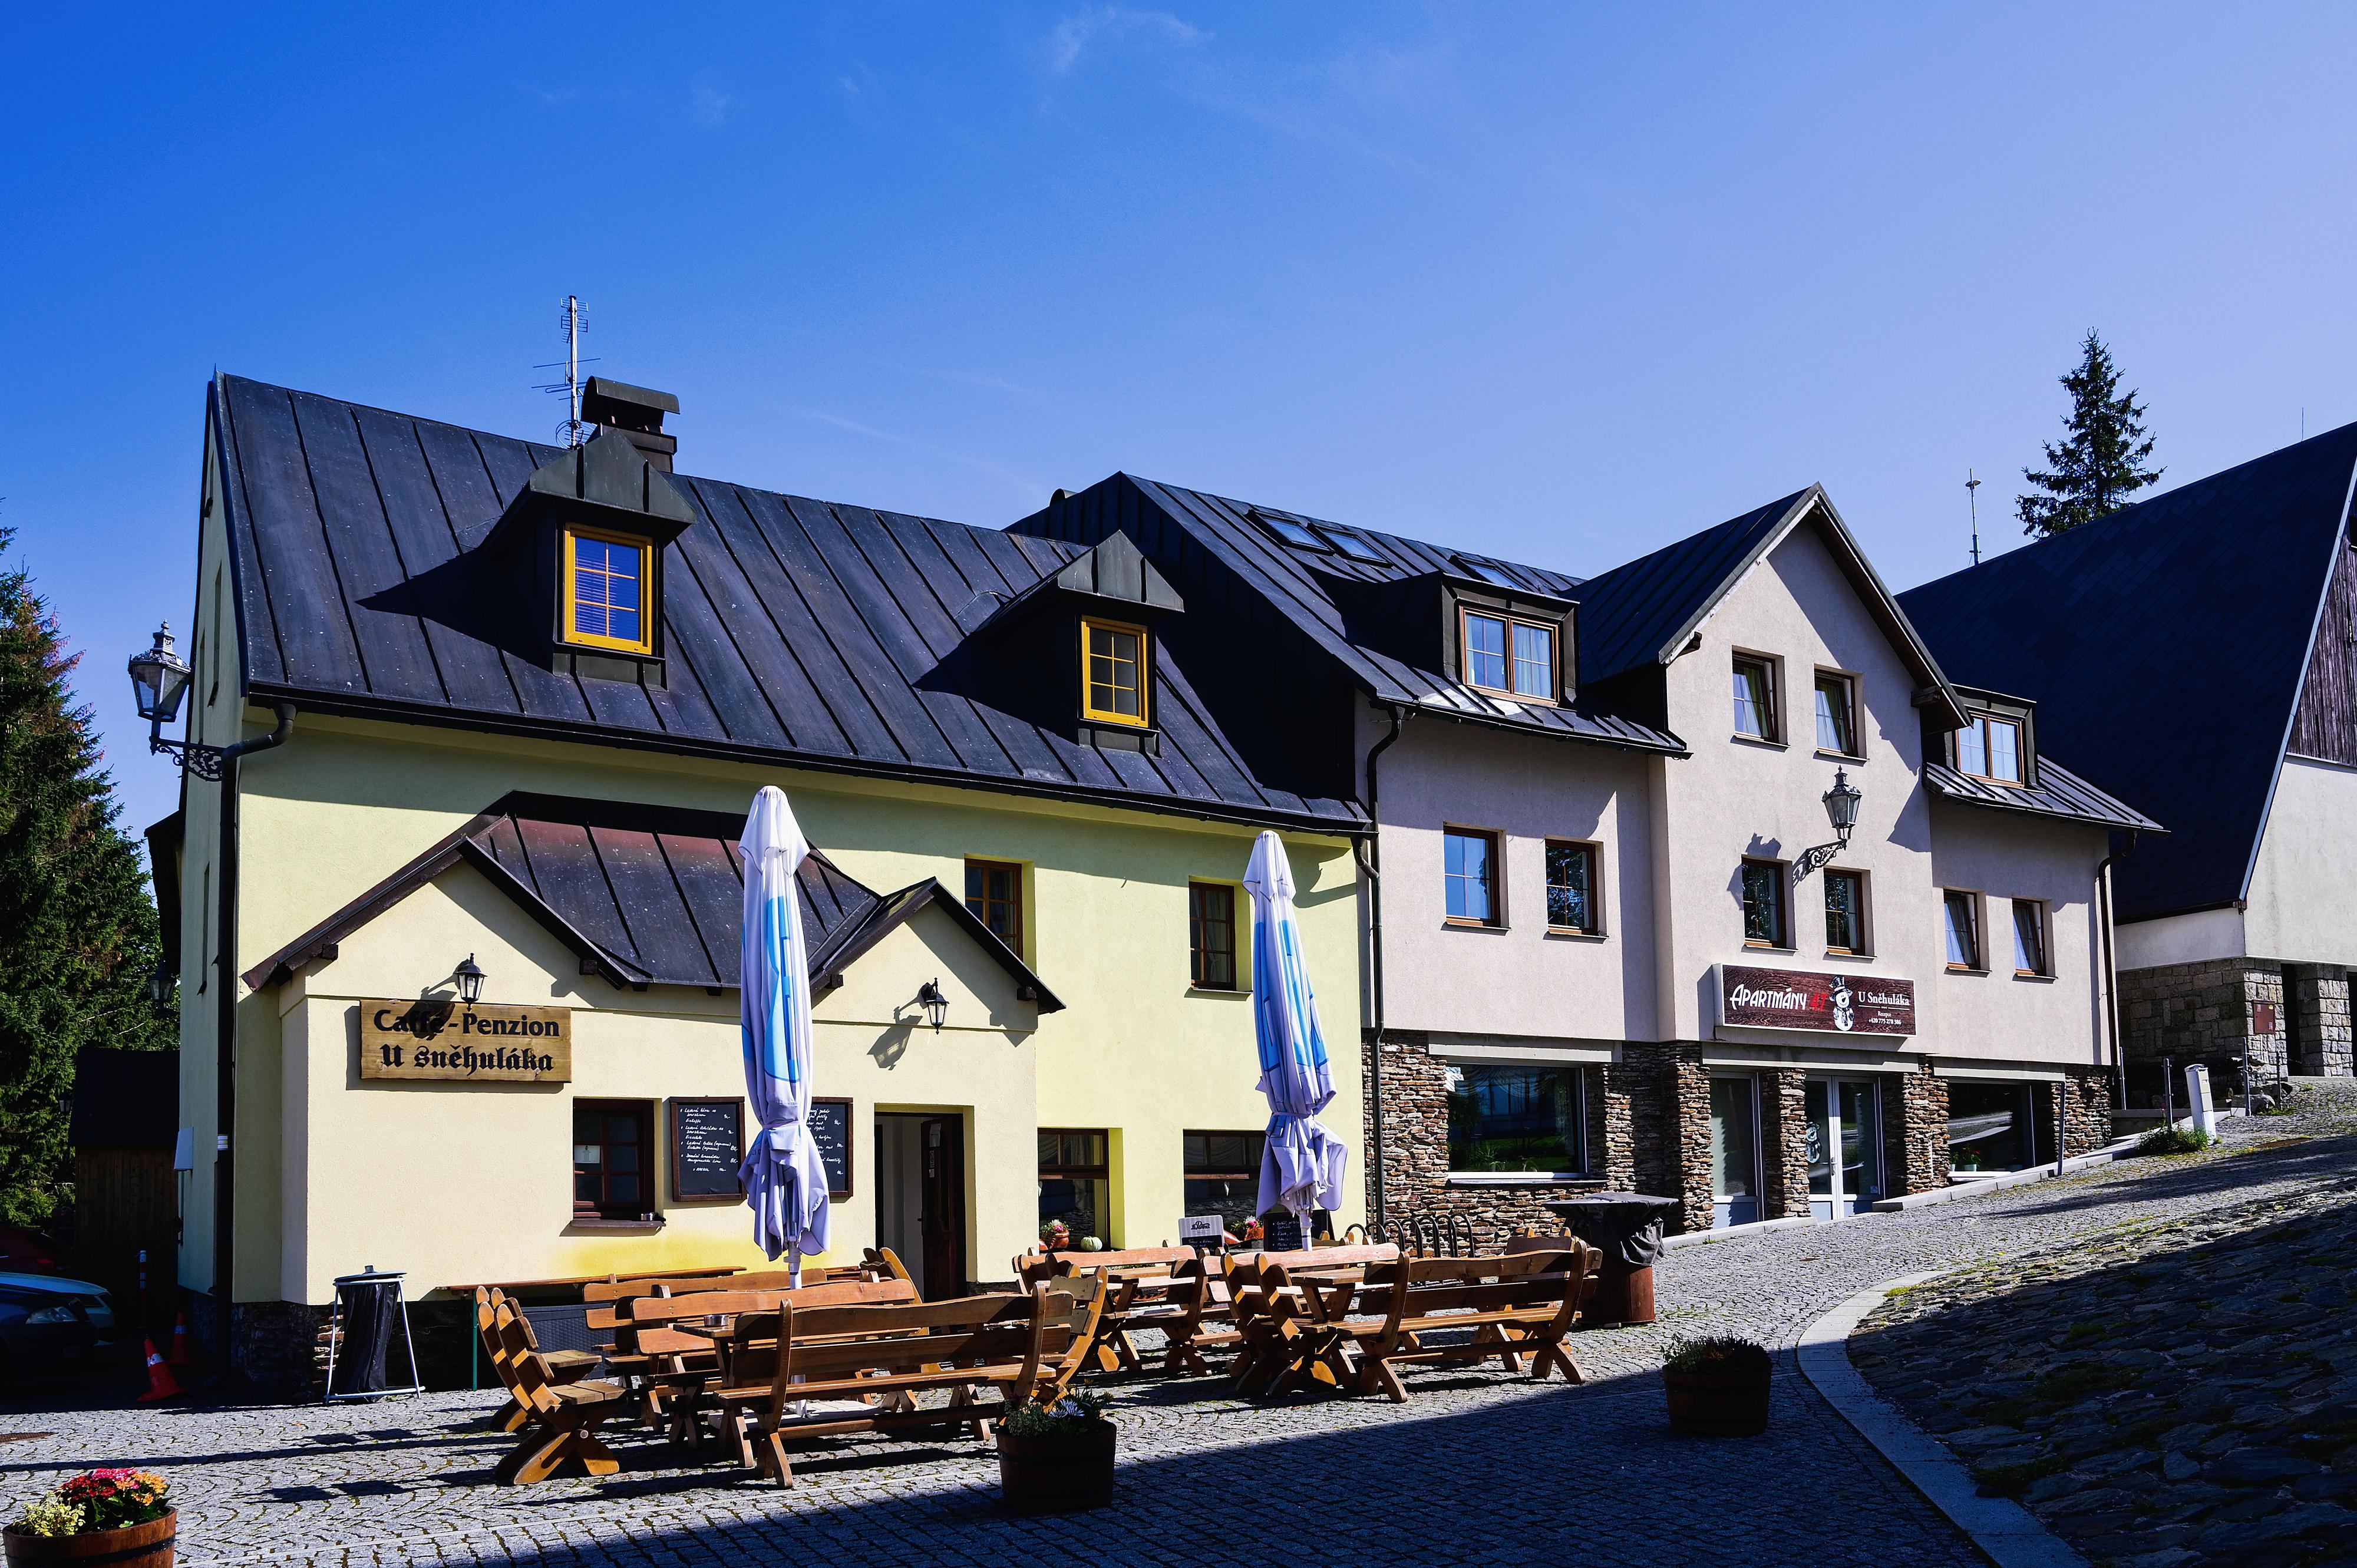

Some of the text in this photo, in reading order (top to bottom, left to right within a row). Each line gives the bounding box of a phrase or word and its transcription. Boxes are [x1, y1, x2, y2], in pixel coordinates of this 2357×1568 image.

[1810, 993, 1827, 1011] 47
[1858, 991, 1910, 1006] U Sněhuláka
